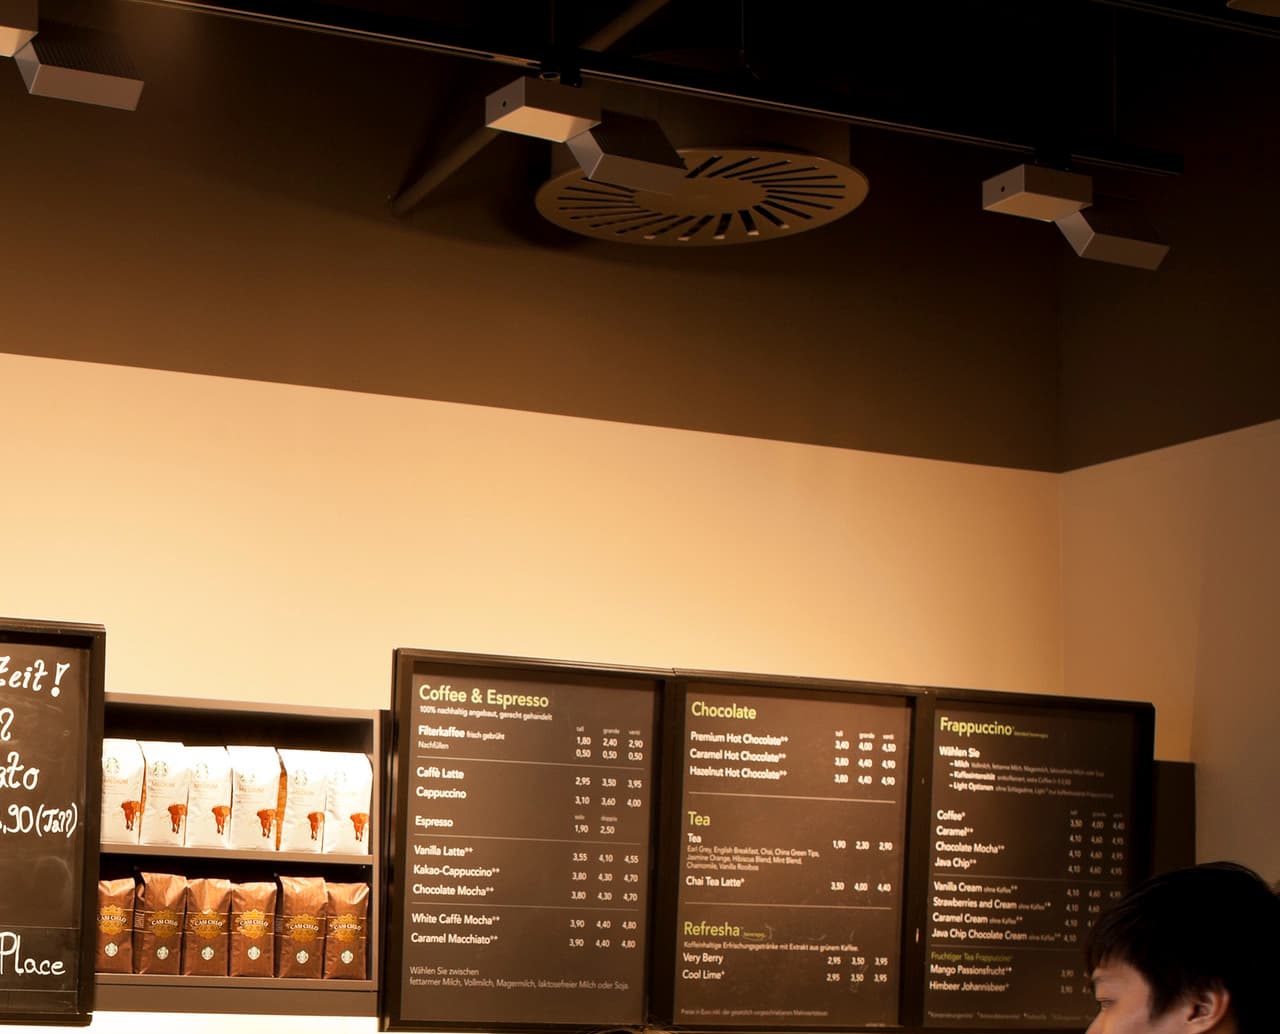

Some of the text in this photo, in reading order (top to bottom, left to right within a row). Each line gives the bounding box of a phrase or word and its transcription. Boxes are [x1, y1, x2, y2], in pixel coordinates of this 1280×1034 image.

[419, 684, 549, 710] Coffee & Espresso
[420, 704, 436, 714] 100%
[691, 701, 757, 720] Chocolate
[418, 725, 465, 738] Filterkaffee
[940, 717, 1012, 737] Frappuccino
[690, 731, 725, 742] Premium
[726, 733, 742, 744] Hot
[576, 749, 591, 758] 0,50
[628, 752, 643, 761] 0,50
[690, 748, 722, 759] Caramel
[724, 750, 740, 760] Hot
[968, 747, 980, 758] Sie
[416, 766, 464, 779] Caffè Latte
[690, 766, 724, 777] Hazelnut
[725, 767, 740, 778] Hot
[416, 786, 467, 799] Cappuccino
[415, 815, 454, 828] Espresso
[688, 811, 711, 826] Tea
[688, 833, 702, 843] Tea
[414, 845, 441, 856] Vanilla
[935, 841, 972, 853] Chocolate
[934, 857, 952, 867] Java
[686, 876, 704, 886] Chai
[705, 876, 720, 886] Tea
[933, 881, 982, 892] Vanilla Cream
[413, 883, 456, 895] Chocolate
[933, 896, 1017, 909] Strawberries and Cream
[412, 913, 437, 924] White
[932, 912, 988, 923] Caramel Cream
[684, 921, 740, 937] Refresha
[932, 928, 1027, 940] Java Chip Chocolate Cream
[411, 933, 446, 943] Caramel
[682, 953, 724, 965] Very Berry
[409, 966, 480, 976] Wählen Sie zwischen
[682, 969, 701, 979] Cool
[930, 964, 956, 976] Mango
[929, 981, 960, 991] Himbeer
